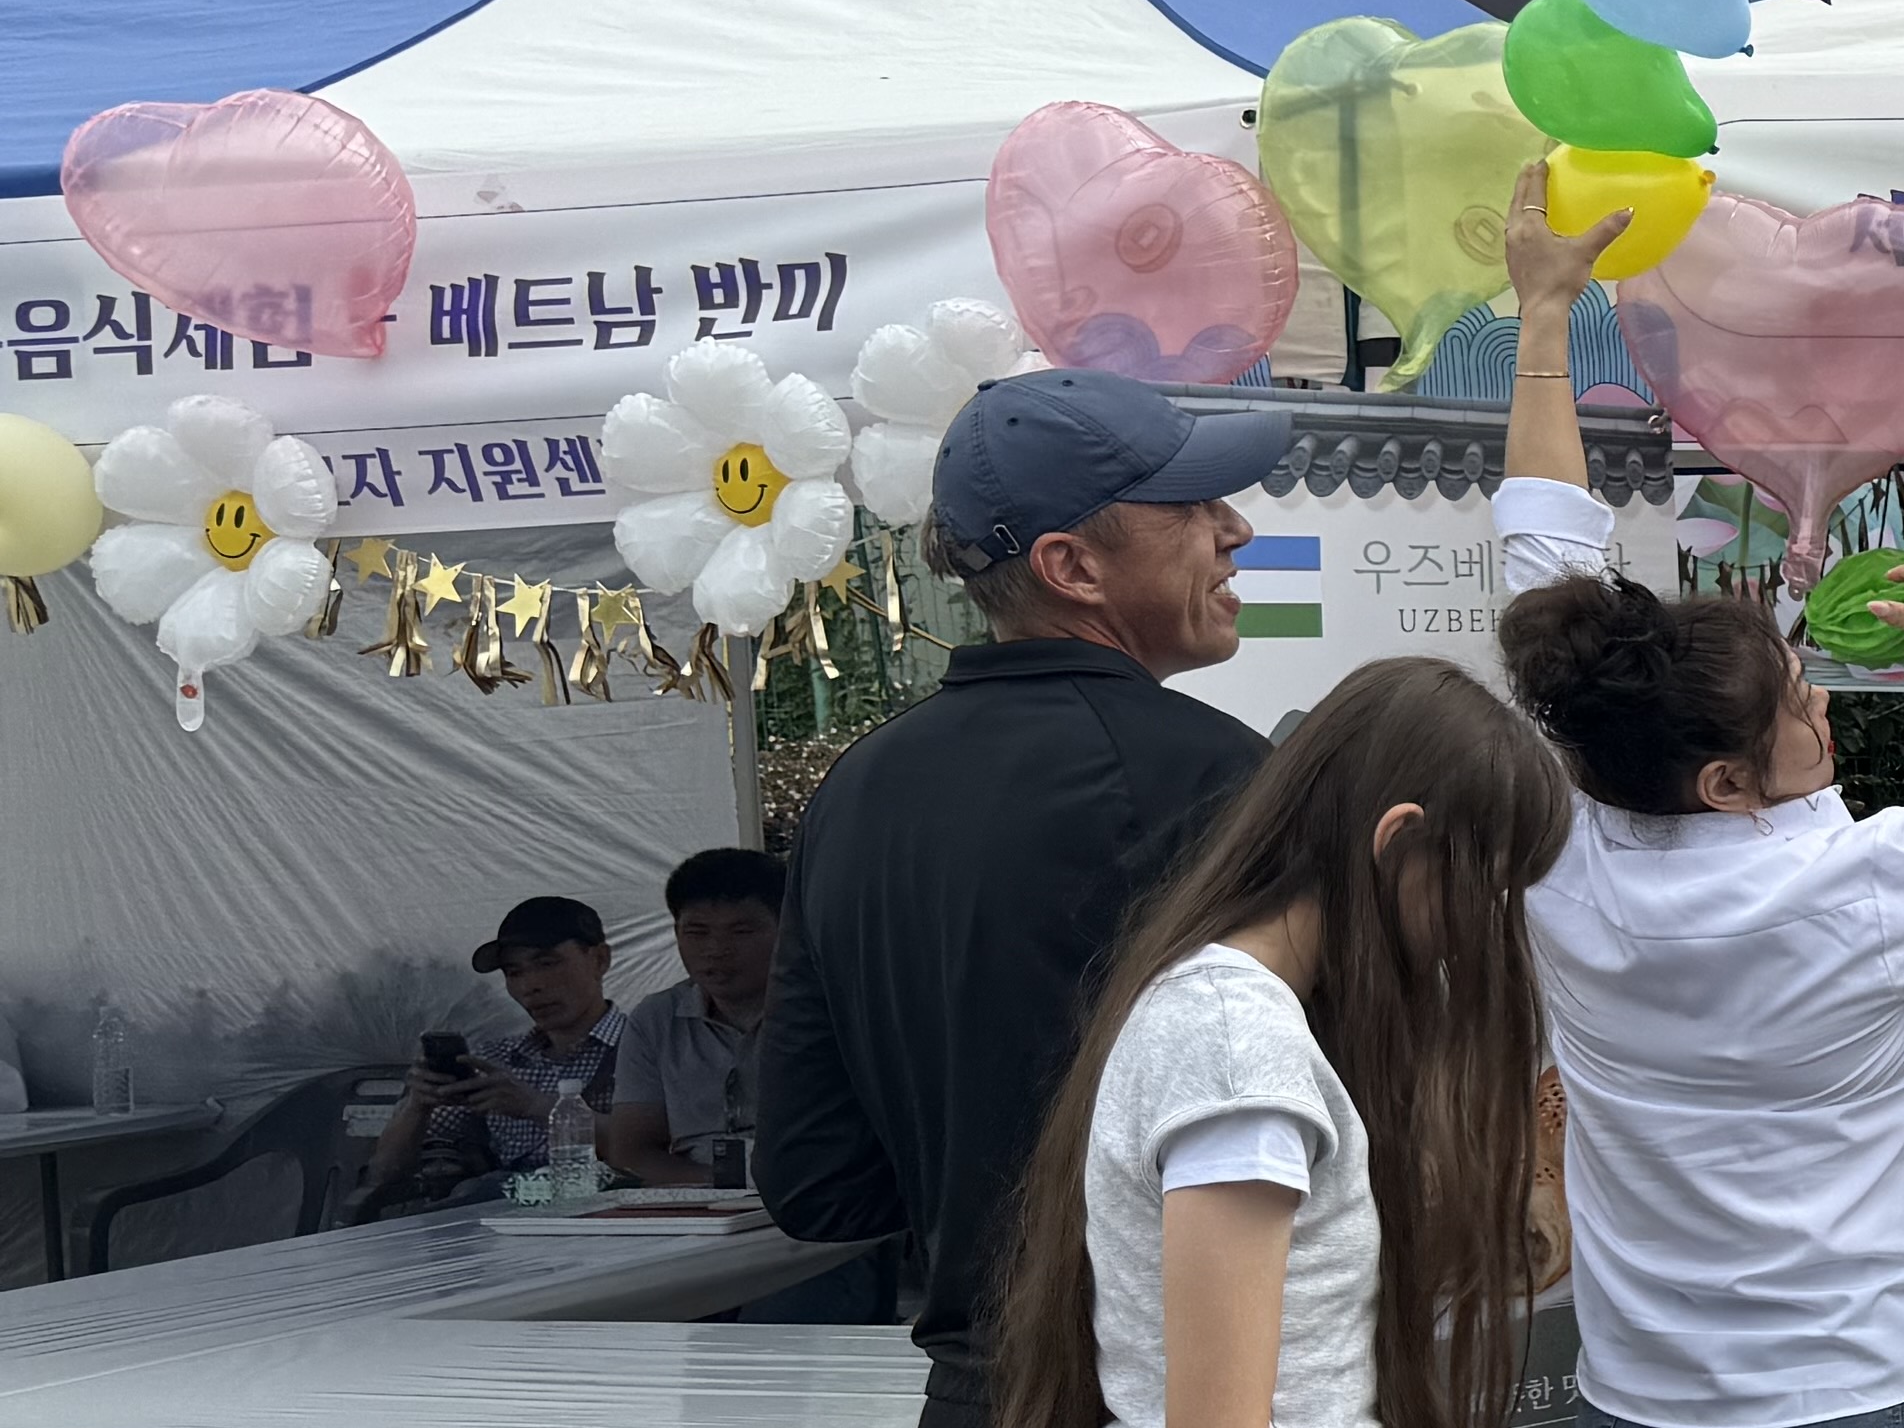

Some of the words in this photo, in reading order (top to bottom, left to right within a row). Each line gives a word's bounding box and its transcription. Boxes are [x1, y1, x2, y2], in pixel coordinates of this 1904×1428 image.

[0, 284, 314, 381] 음식체험
[428, 264, 664, 358] 베트남
[690, 252, 846, 341] 반미
[416, 439, 605, 504] 지원센
